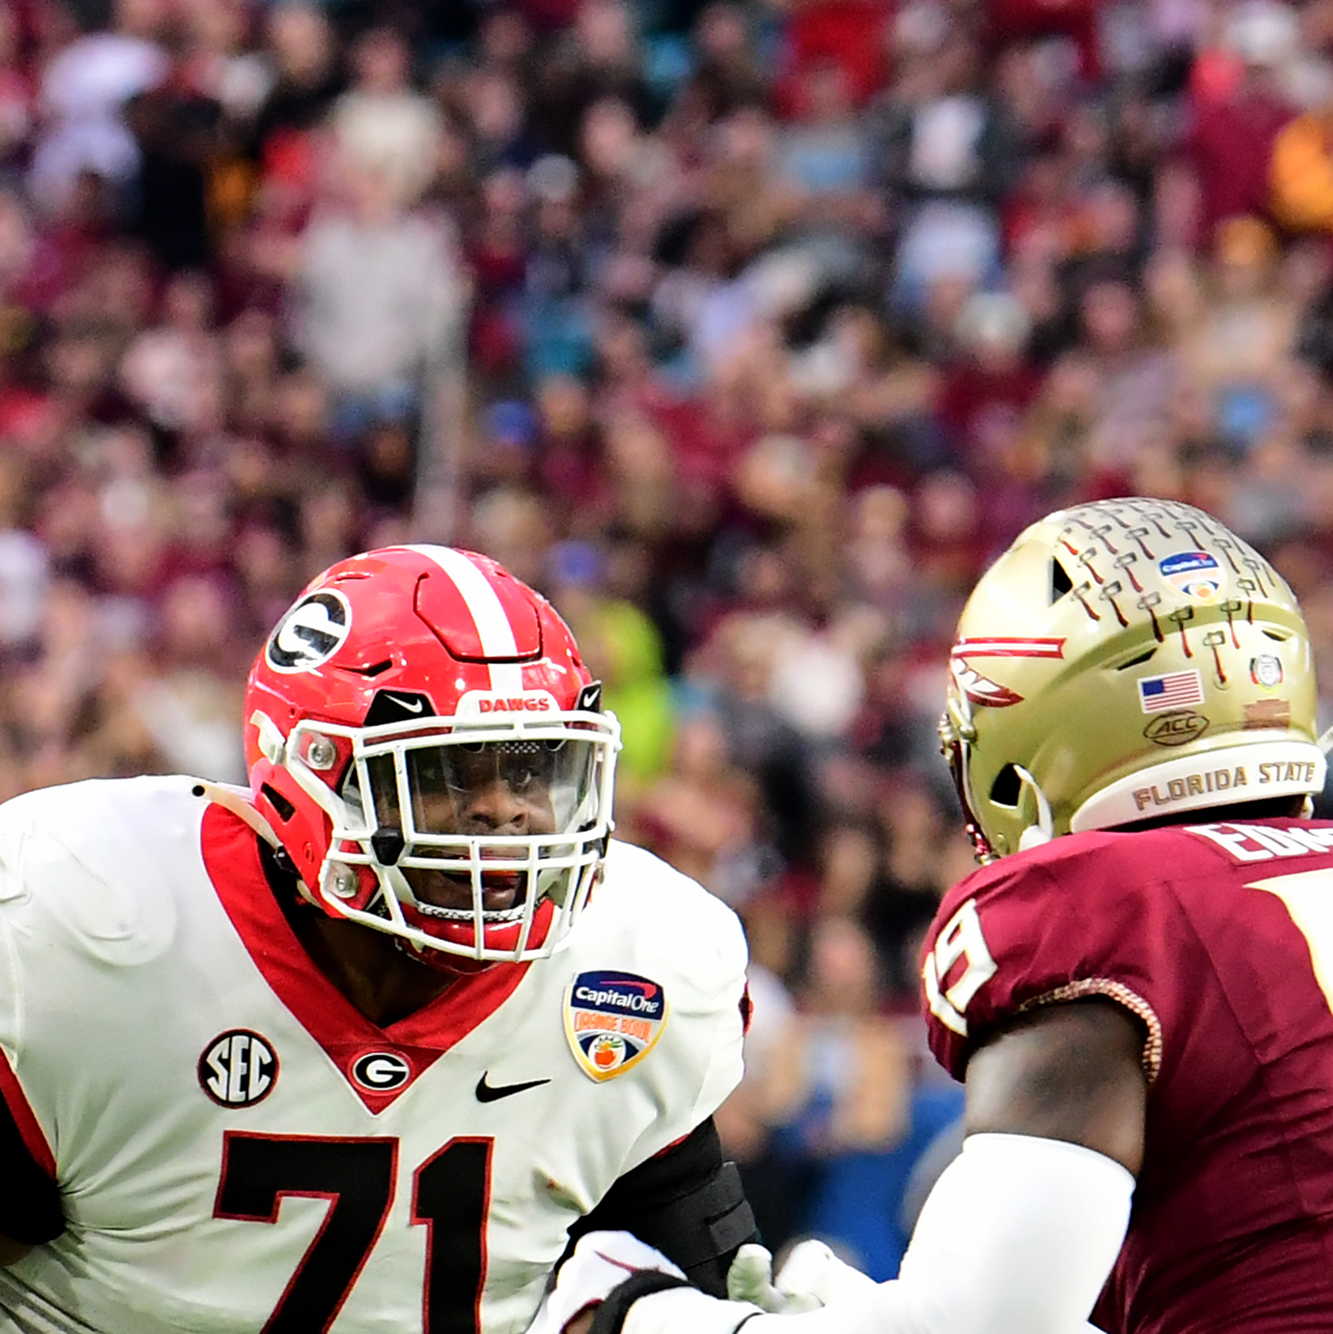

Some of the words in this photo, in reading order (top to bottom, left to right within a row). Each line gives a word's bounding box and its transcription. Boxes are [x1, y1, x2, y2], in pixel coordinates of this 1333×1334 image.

[269, 593, 349, 670] G
[478, 697, 550, 714] DAWGS
[1155, 717, 1198, 735] ACC
[1133, 766, 1248, 811] FLORIDA
[1259, 761, 1316, 784] STATE
[575, 986, 660, 1013] CapitalOne
[574, 1010, 617, 1032] ORANGE
[620, 1018, 652, 1043] BOWL
[205, 1035, 273, 1103] SEC
[359, 1055, 410, 1087] G
